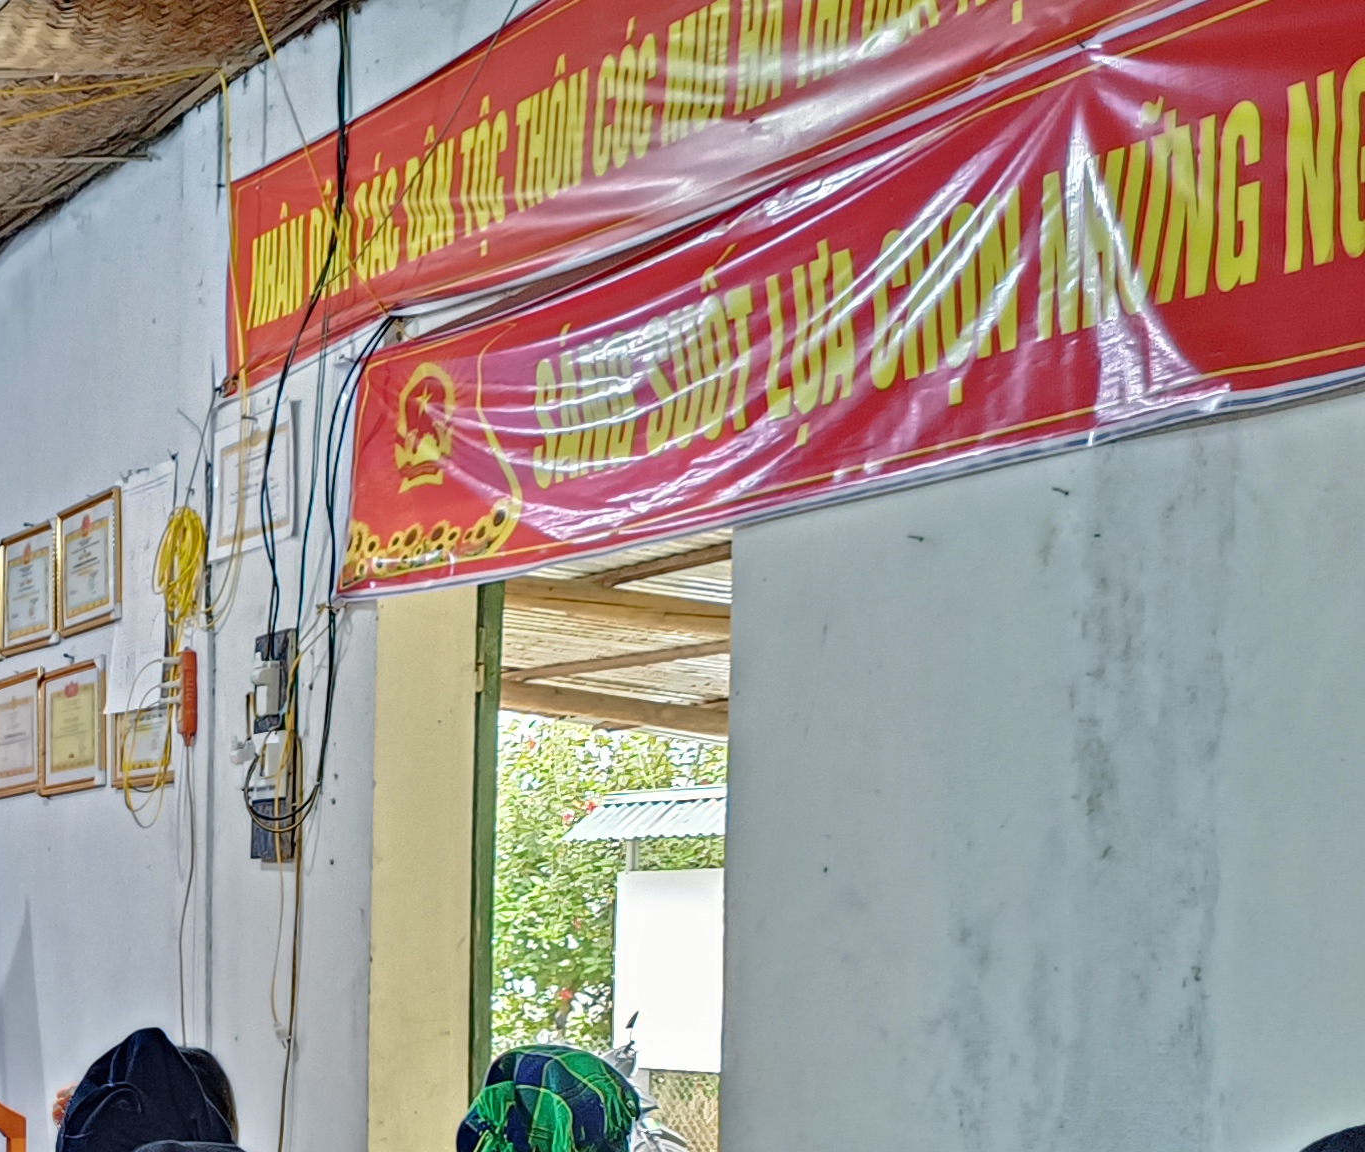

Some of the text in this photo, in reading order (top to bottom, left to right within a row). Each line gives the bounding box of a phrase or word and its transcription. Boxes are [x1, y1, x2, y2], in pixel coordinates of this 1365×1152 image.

[246, 201, 305, 331] NHÂN
[354, 151, 400, 283] CÁC
[402, 125, 455, 263] DÂN
[460, 95, 508, 257] TỘC
[515, 53, 589, 213] THÔN
[646, 242, 753, 457] SUỐT
[765, 239, 855, 446] LỰA
[871, 185, 1019, 406] CHỌN
[1037, 95, 1261, 341] NHỮNG
